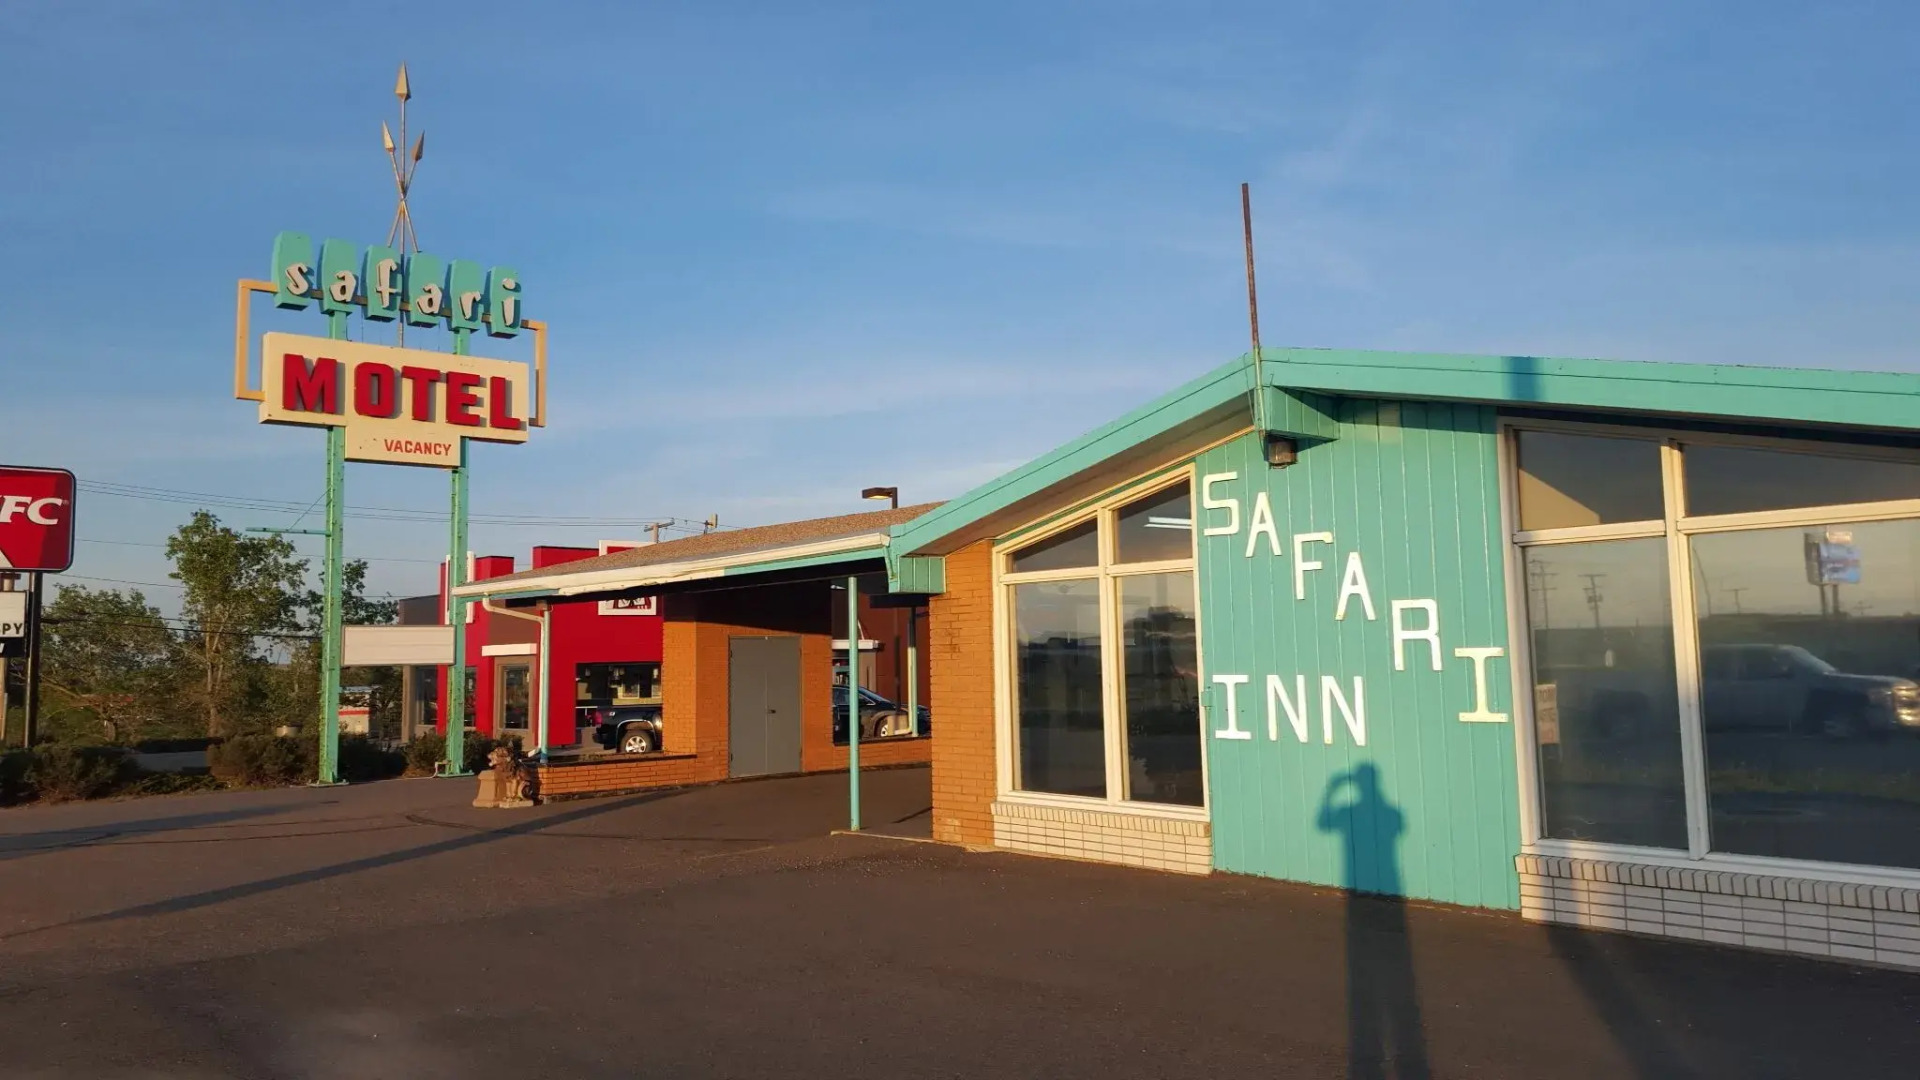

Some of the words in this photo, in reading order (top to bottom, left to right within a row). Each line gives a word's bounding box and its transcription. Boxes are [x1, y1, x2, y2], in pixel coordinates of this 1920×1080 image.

[285, 258, 516, 327] safari
[282, 353, 521, 429] MOTEL
[384, 438, 452, 456] VACANCY
[0, 495, 63, 525] FC
[1202, 471, 1509, 723] SAFARI
[1212, 674, 1366, 747] INN
